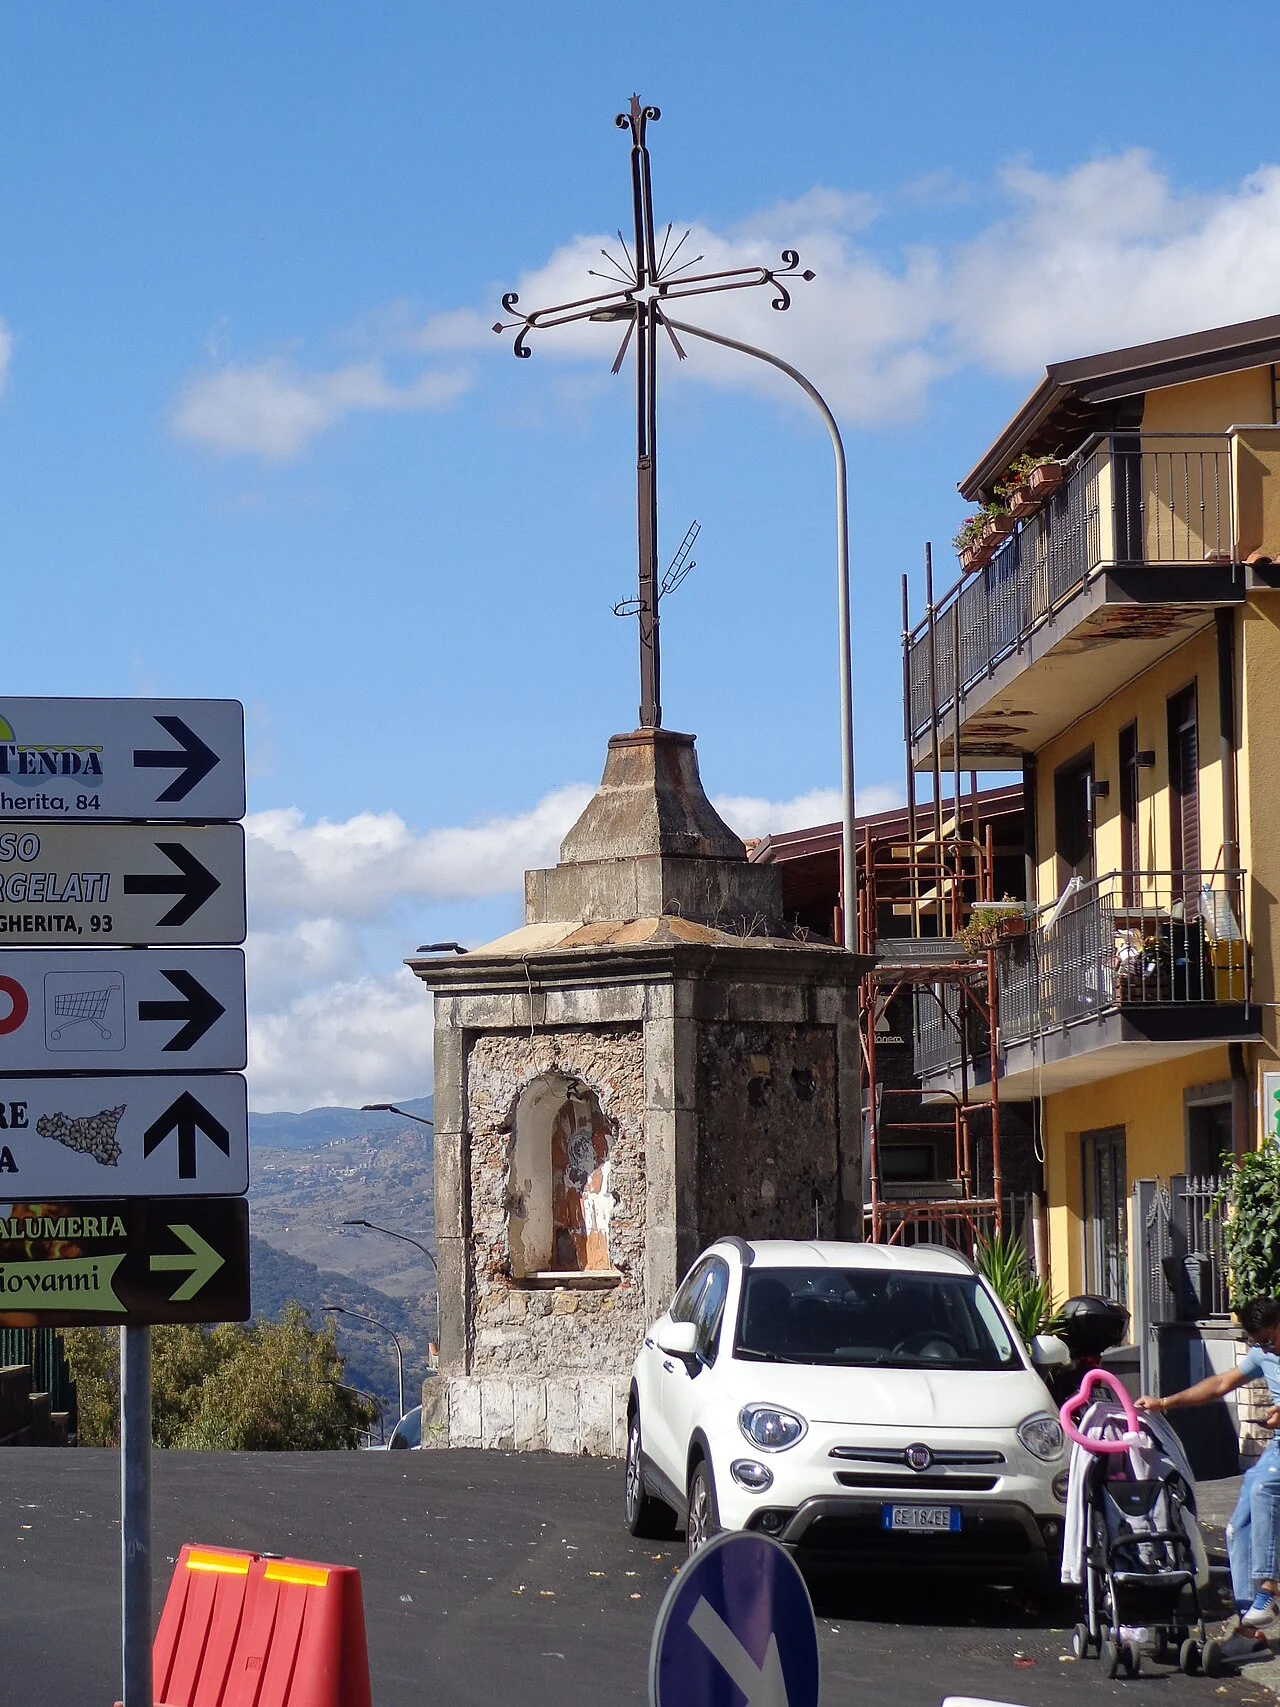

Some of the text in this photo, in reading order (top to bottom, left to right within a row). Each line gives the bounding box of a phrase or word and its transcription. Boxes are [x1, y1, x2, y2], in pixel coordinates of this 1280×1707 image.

[1, 793, 101, 812] herita, 84
[0, 833, 41, 863] SO
[0, 872, 110, 903] GELATI
[90, 914, 113, 933] 93
